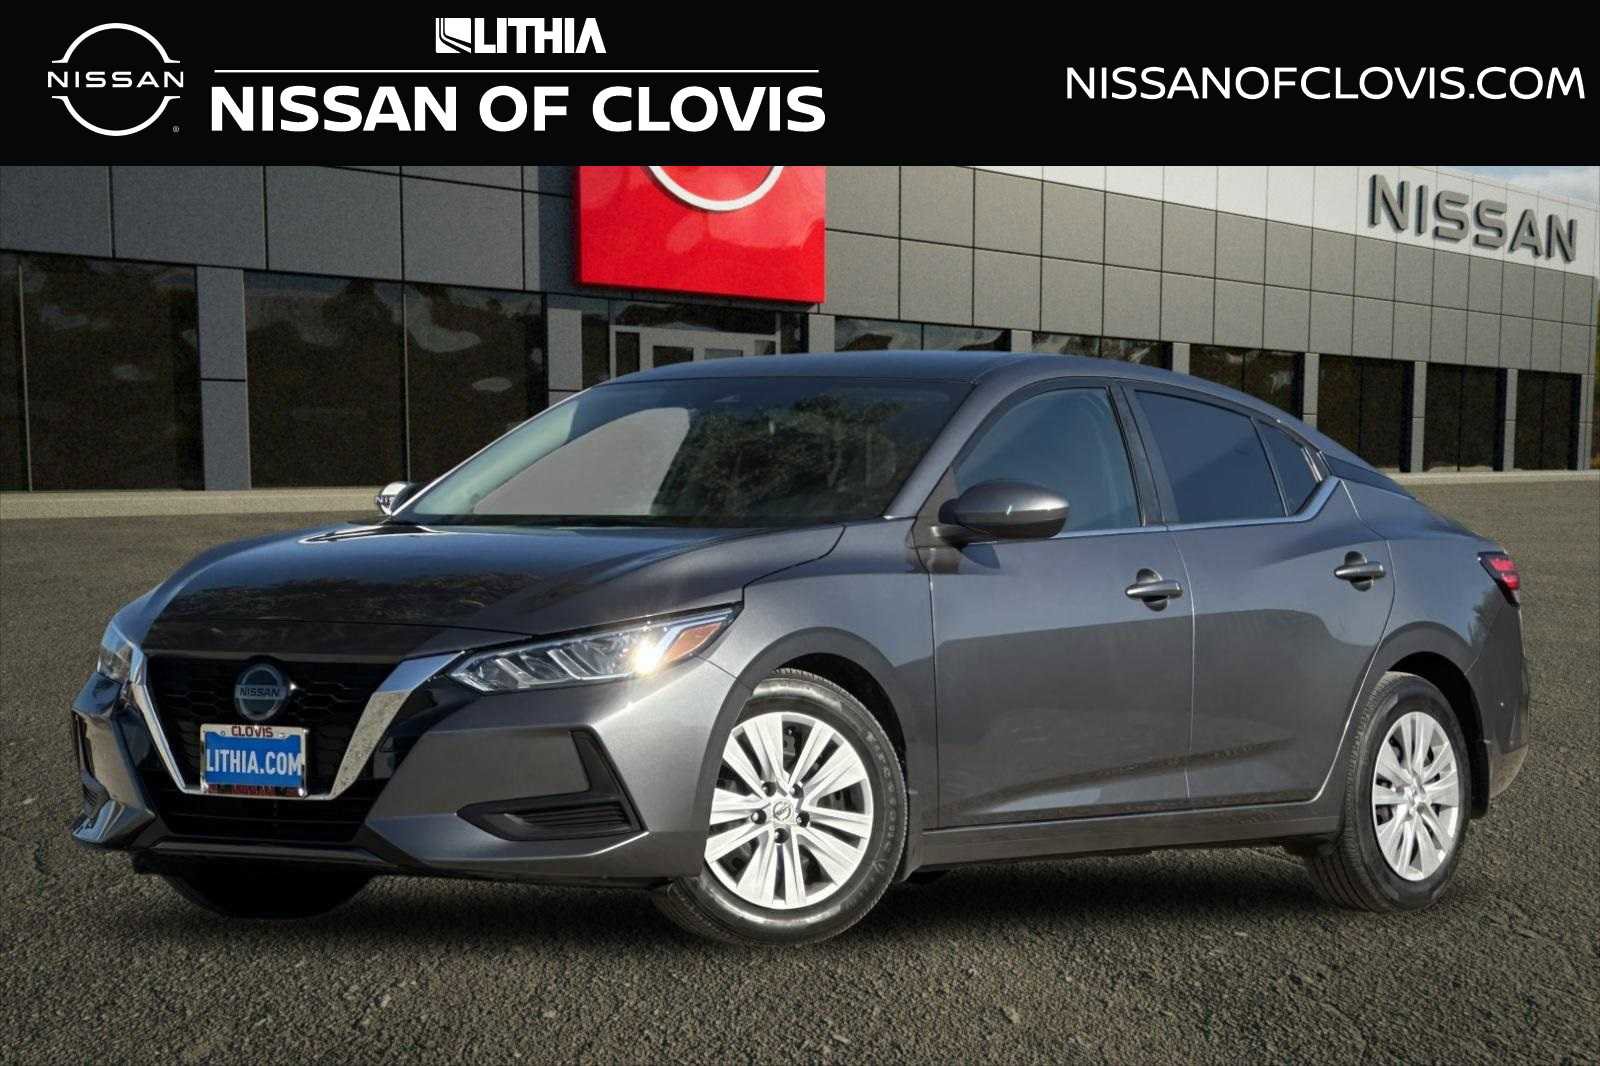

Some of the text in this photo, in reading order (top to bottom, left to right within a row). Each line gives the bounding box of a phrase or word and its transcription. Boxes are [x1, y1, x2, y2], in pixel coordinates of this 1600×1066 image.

[1368, 174, 1578, 262] NISSAN
[239, 686, 281, 697] NISSAN
[231, 725, 274, 737] CLOVIS
[206, 748, 302, 776] LITHIA.COM
